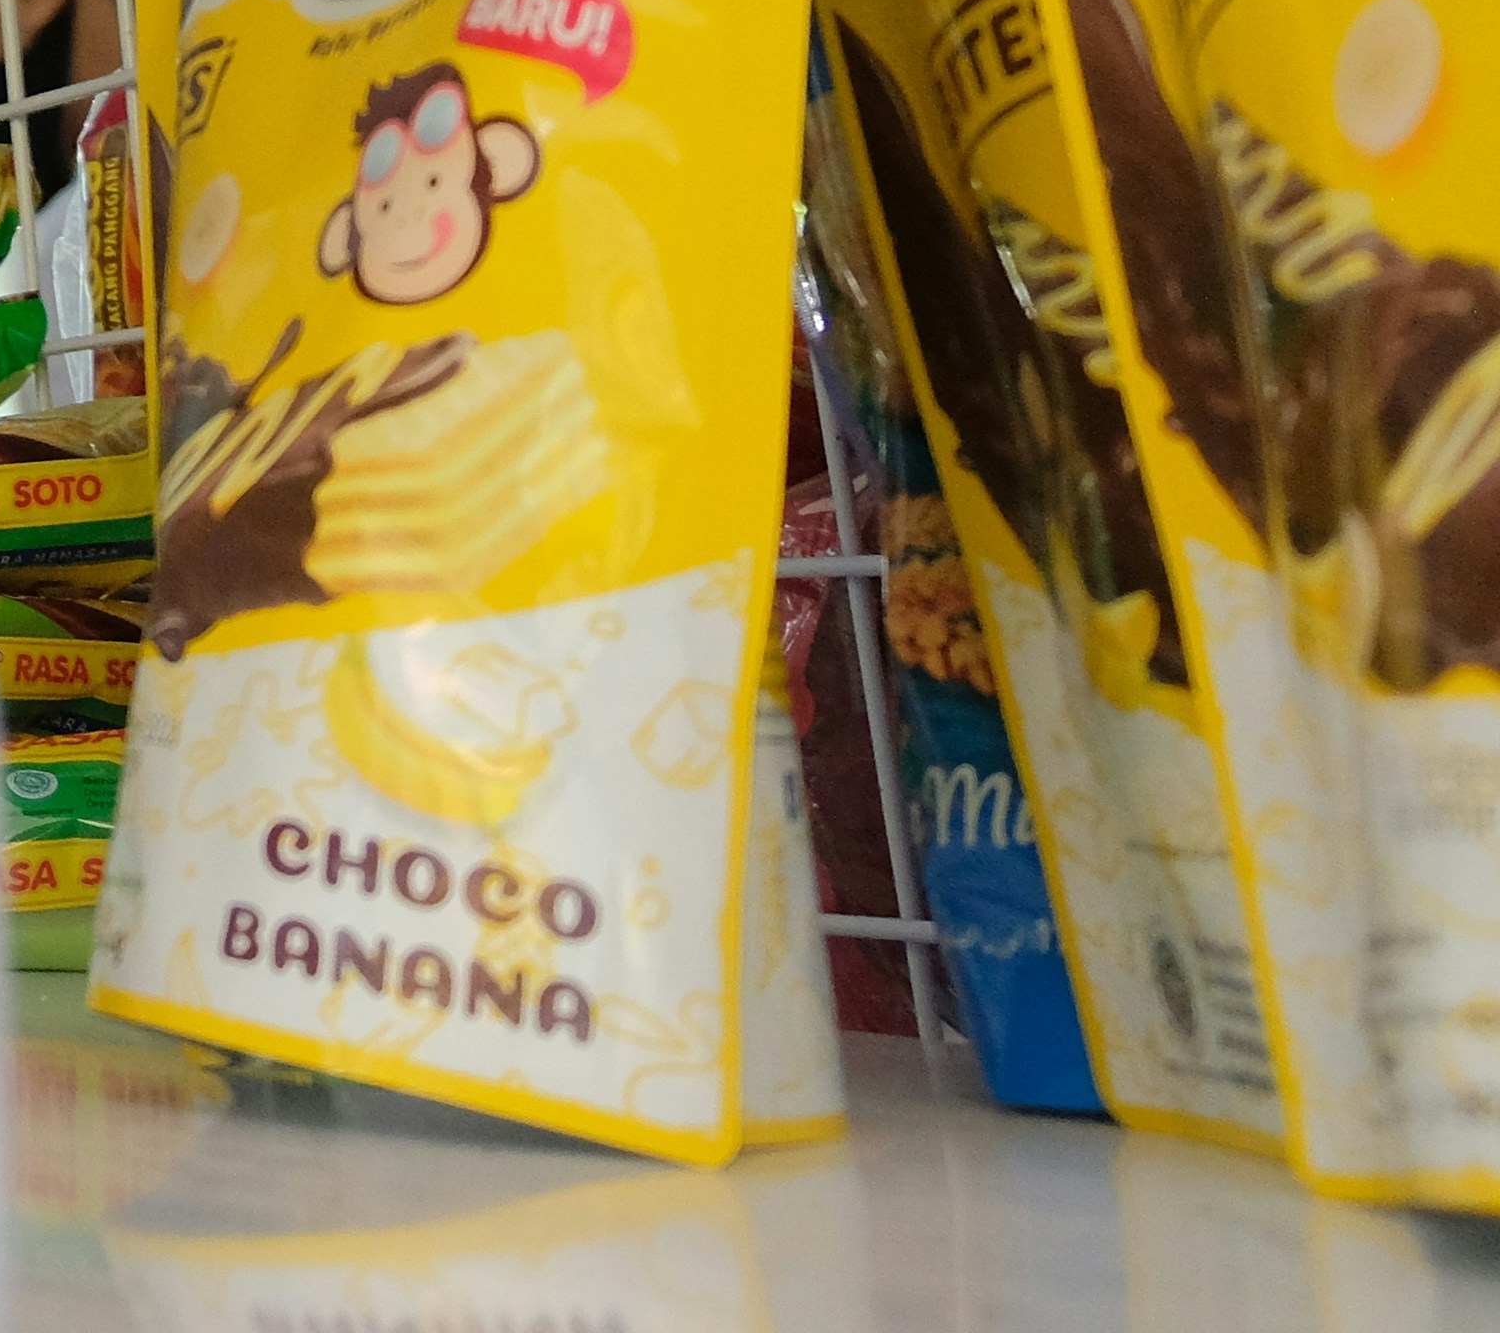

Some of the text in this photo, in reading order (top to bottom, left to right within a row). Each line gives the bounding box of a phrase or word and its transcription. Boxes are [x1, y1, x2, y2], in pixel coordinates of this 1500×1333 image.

[103, 156, 121, 258] PANGGANG
[13, 473, 104, 510] SOTO
[14, 653, 90, 685] RASA
[264, 820, 598, 941] CHOCO
[221, 904, 593, 1044] BANANA
